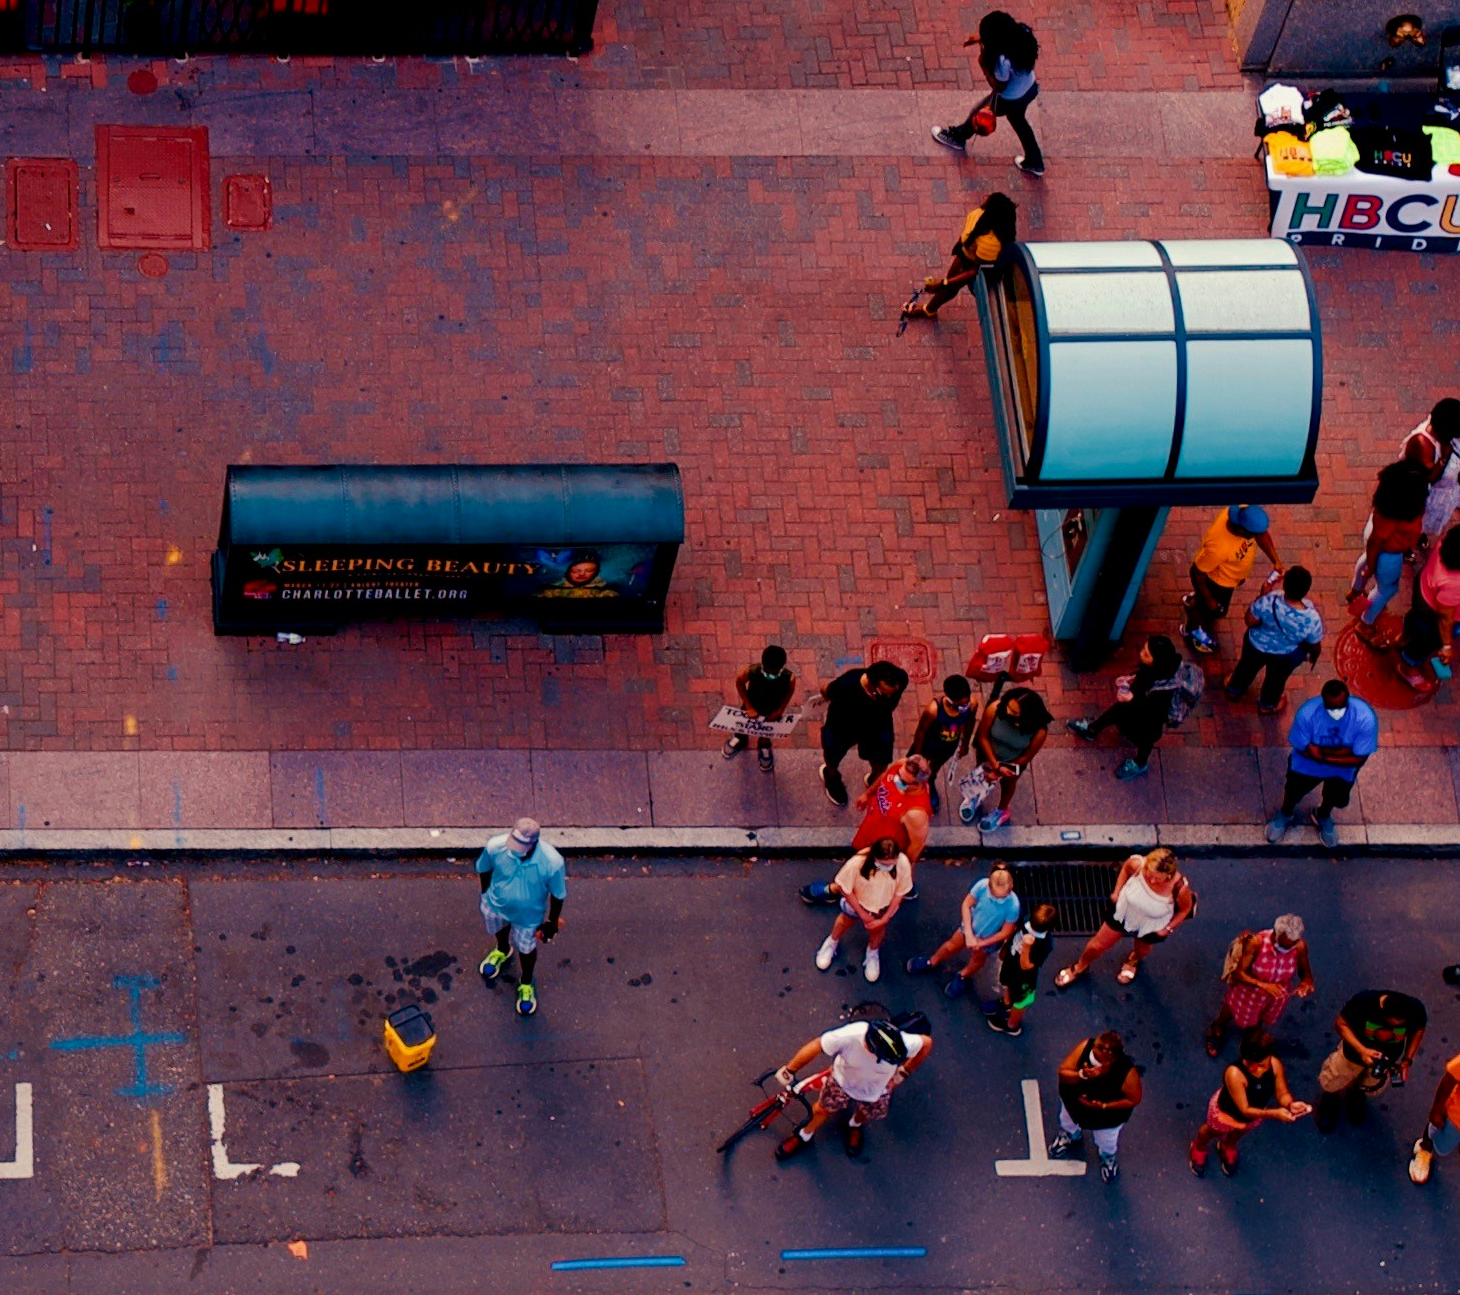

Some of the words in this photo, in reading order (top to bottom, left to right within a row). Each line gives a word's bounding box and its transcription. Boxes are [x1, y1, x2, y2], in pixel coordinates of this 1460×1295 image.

[282, 557, 414, 574] SLEEPING
[426, 559, 541, 576] BEAUTY
[281, 588, 468, 600] CHARLOTTEBALLET.ORG
